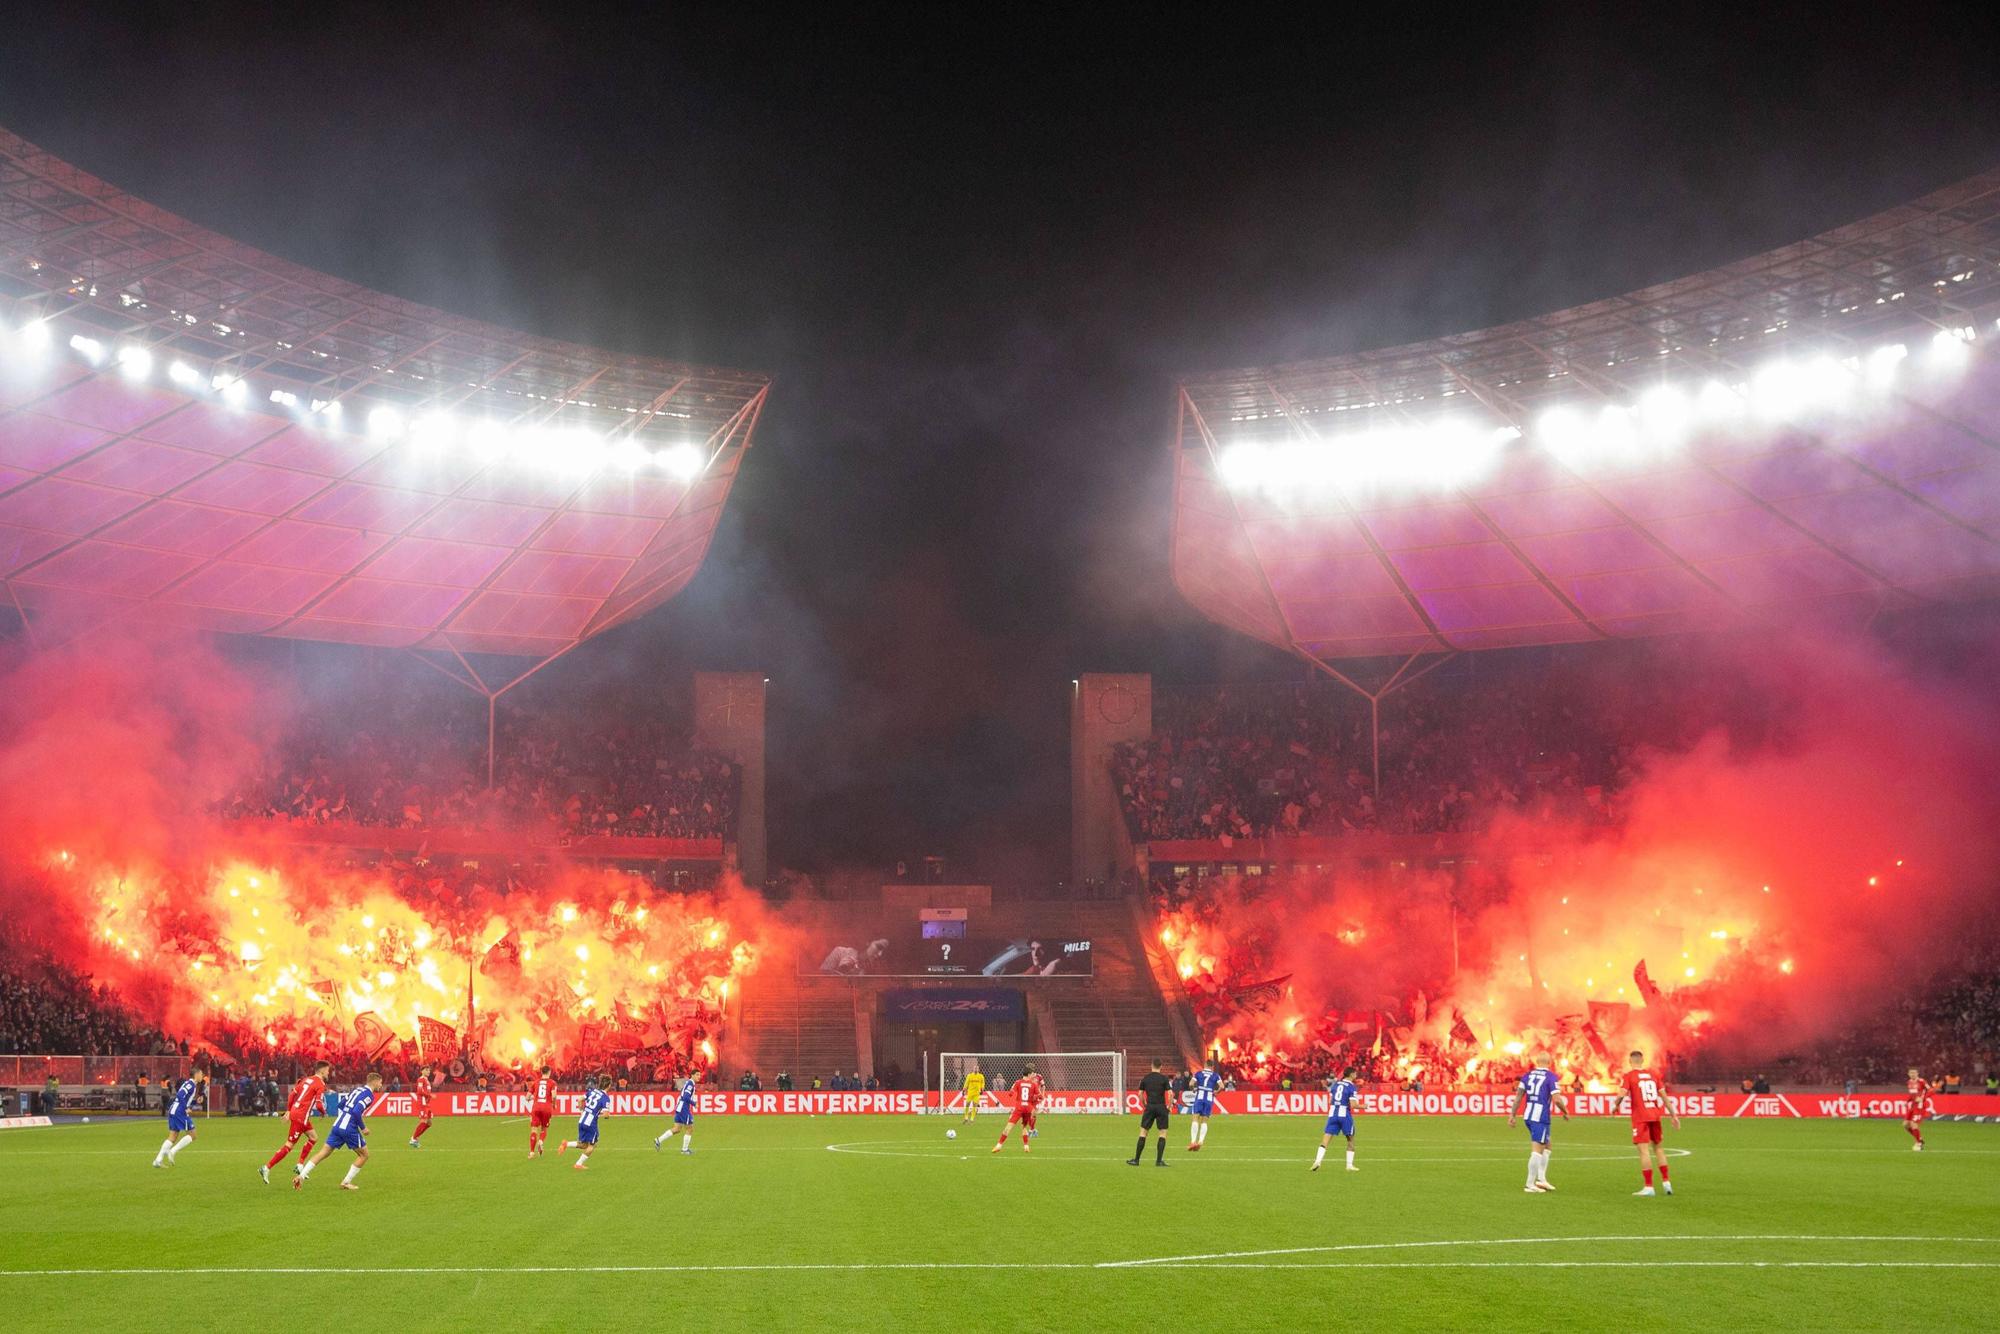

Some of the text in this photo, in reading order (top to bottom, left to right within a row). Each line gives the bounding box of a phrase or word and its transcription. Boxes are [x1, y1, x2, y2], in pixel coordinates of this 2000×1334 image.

[1064, 941, 1090, 952] MILES
[1203, 1073, 1211, 1087] 7
[1527, 1074, 1547, 1095] 37
[538, 1084, 547, 1099] 6
[1021, 1087, 1030, 1101] 8
[1335, 1085, 1344, 1101] 8
[1638, 1080, 1658, 1102] 19
[387, 1097, 412, 1114] WTG
[452, 1095, 534, 1114] LEADIN
[734, 1094, 777, 1113] FOR
[783, 1094, 924, 1113] ENTERPRISE
[586, 1091, 602, 1109] 33
[1247, 1094, 1329, 1113] LEADIN
[1754, 1098, 1780, 1115] WTG
